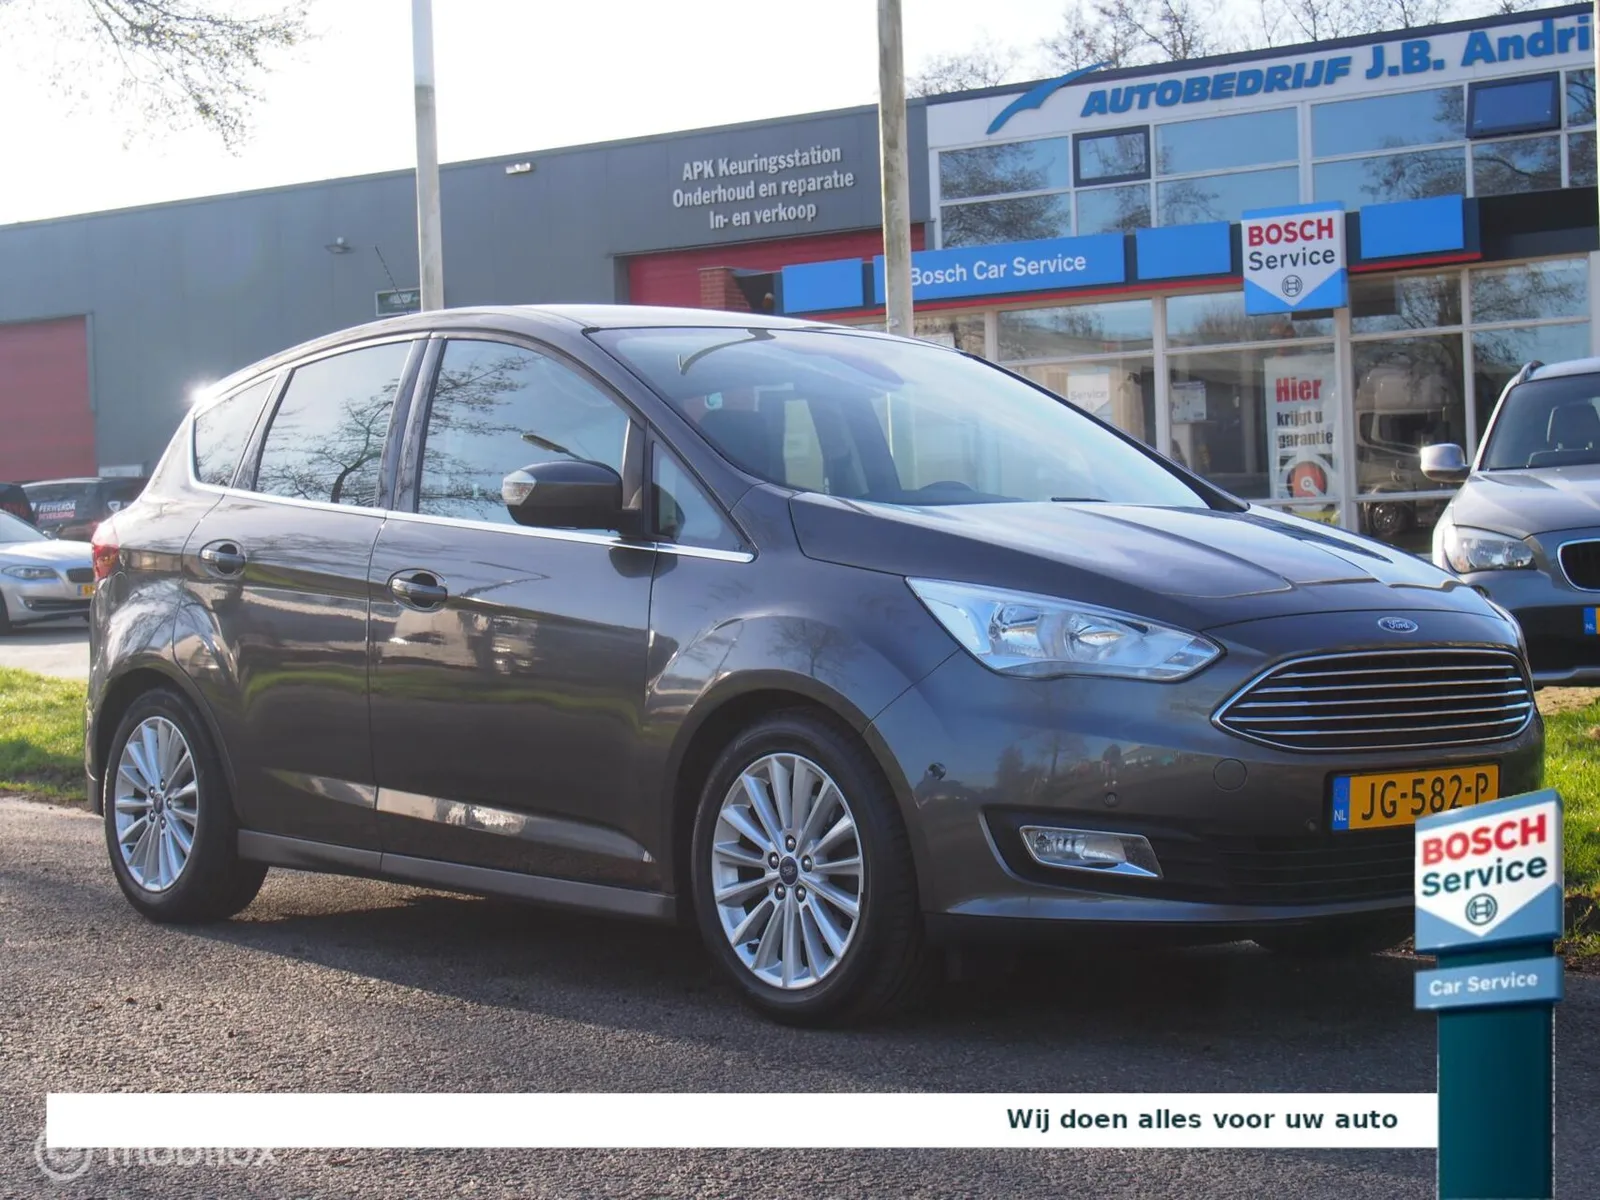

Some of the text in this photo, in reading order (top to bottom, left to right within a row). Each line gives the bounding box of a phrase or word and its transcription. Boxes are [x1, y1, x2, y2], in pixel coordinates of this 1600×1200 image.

[1080, 56, 1353, 117] AUTOBEDRIJF
[1365, 40, 1445, 80] J.B.
[682, 145, 842, 181] APK Keuringsstation
[673, 170, 855, 208] Onderhoud en reparatie
[710, 202, 817, 229] In- en verkoop
[1248, 217, 1334, 247] BOSCH
[911, 253, 1087, 286] Bosch Car Service
[1248, 247, 1335, 271] Service
[1276, 377, 1322, 402] Hier
[1276, 410, 1323, 427] krijgt u
[1278, 430, 1333, 449] garantie
[1334, 772, 1489, 821] NL JG-582-P
